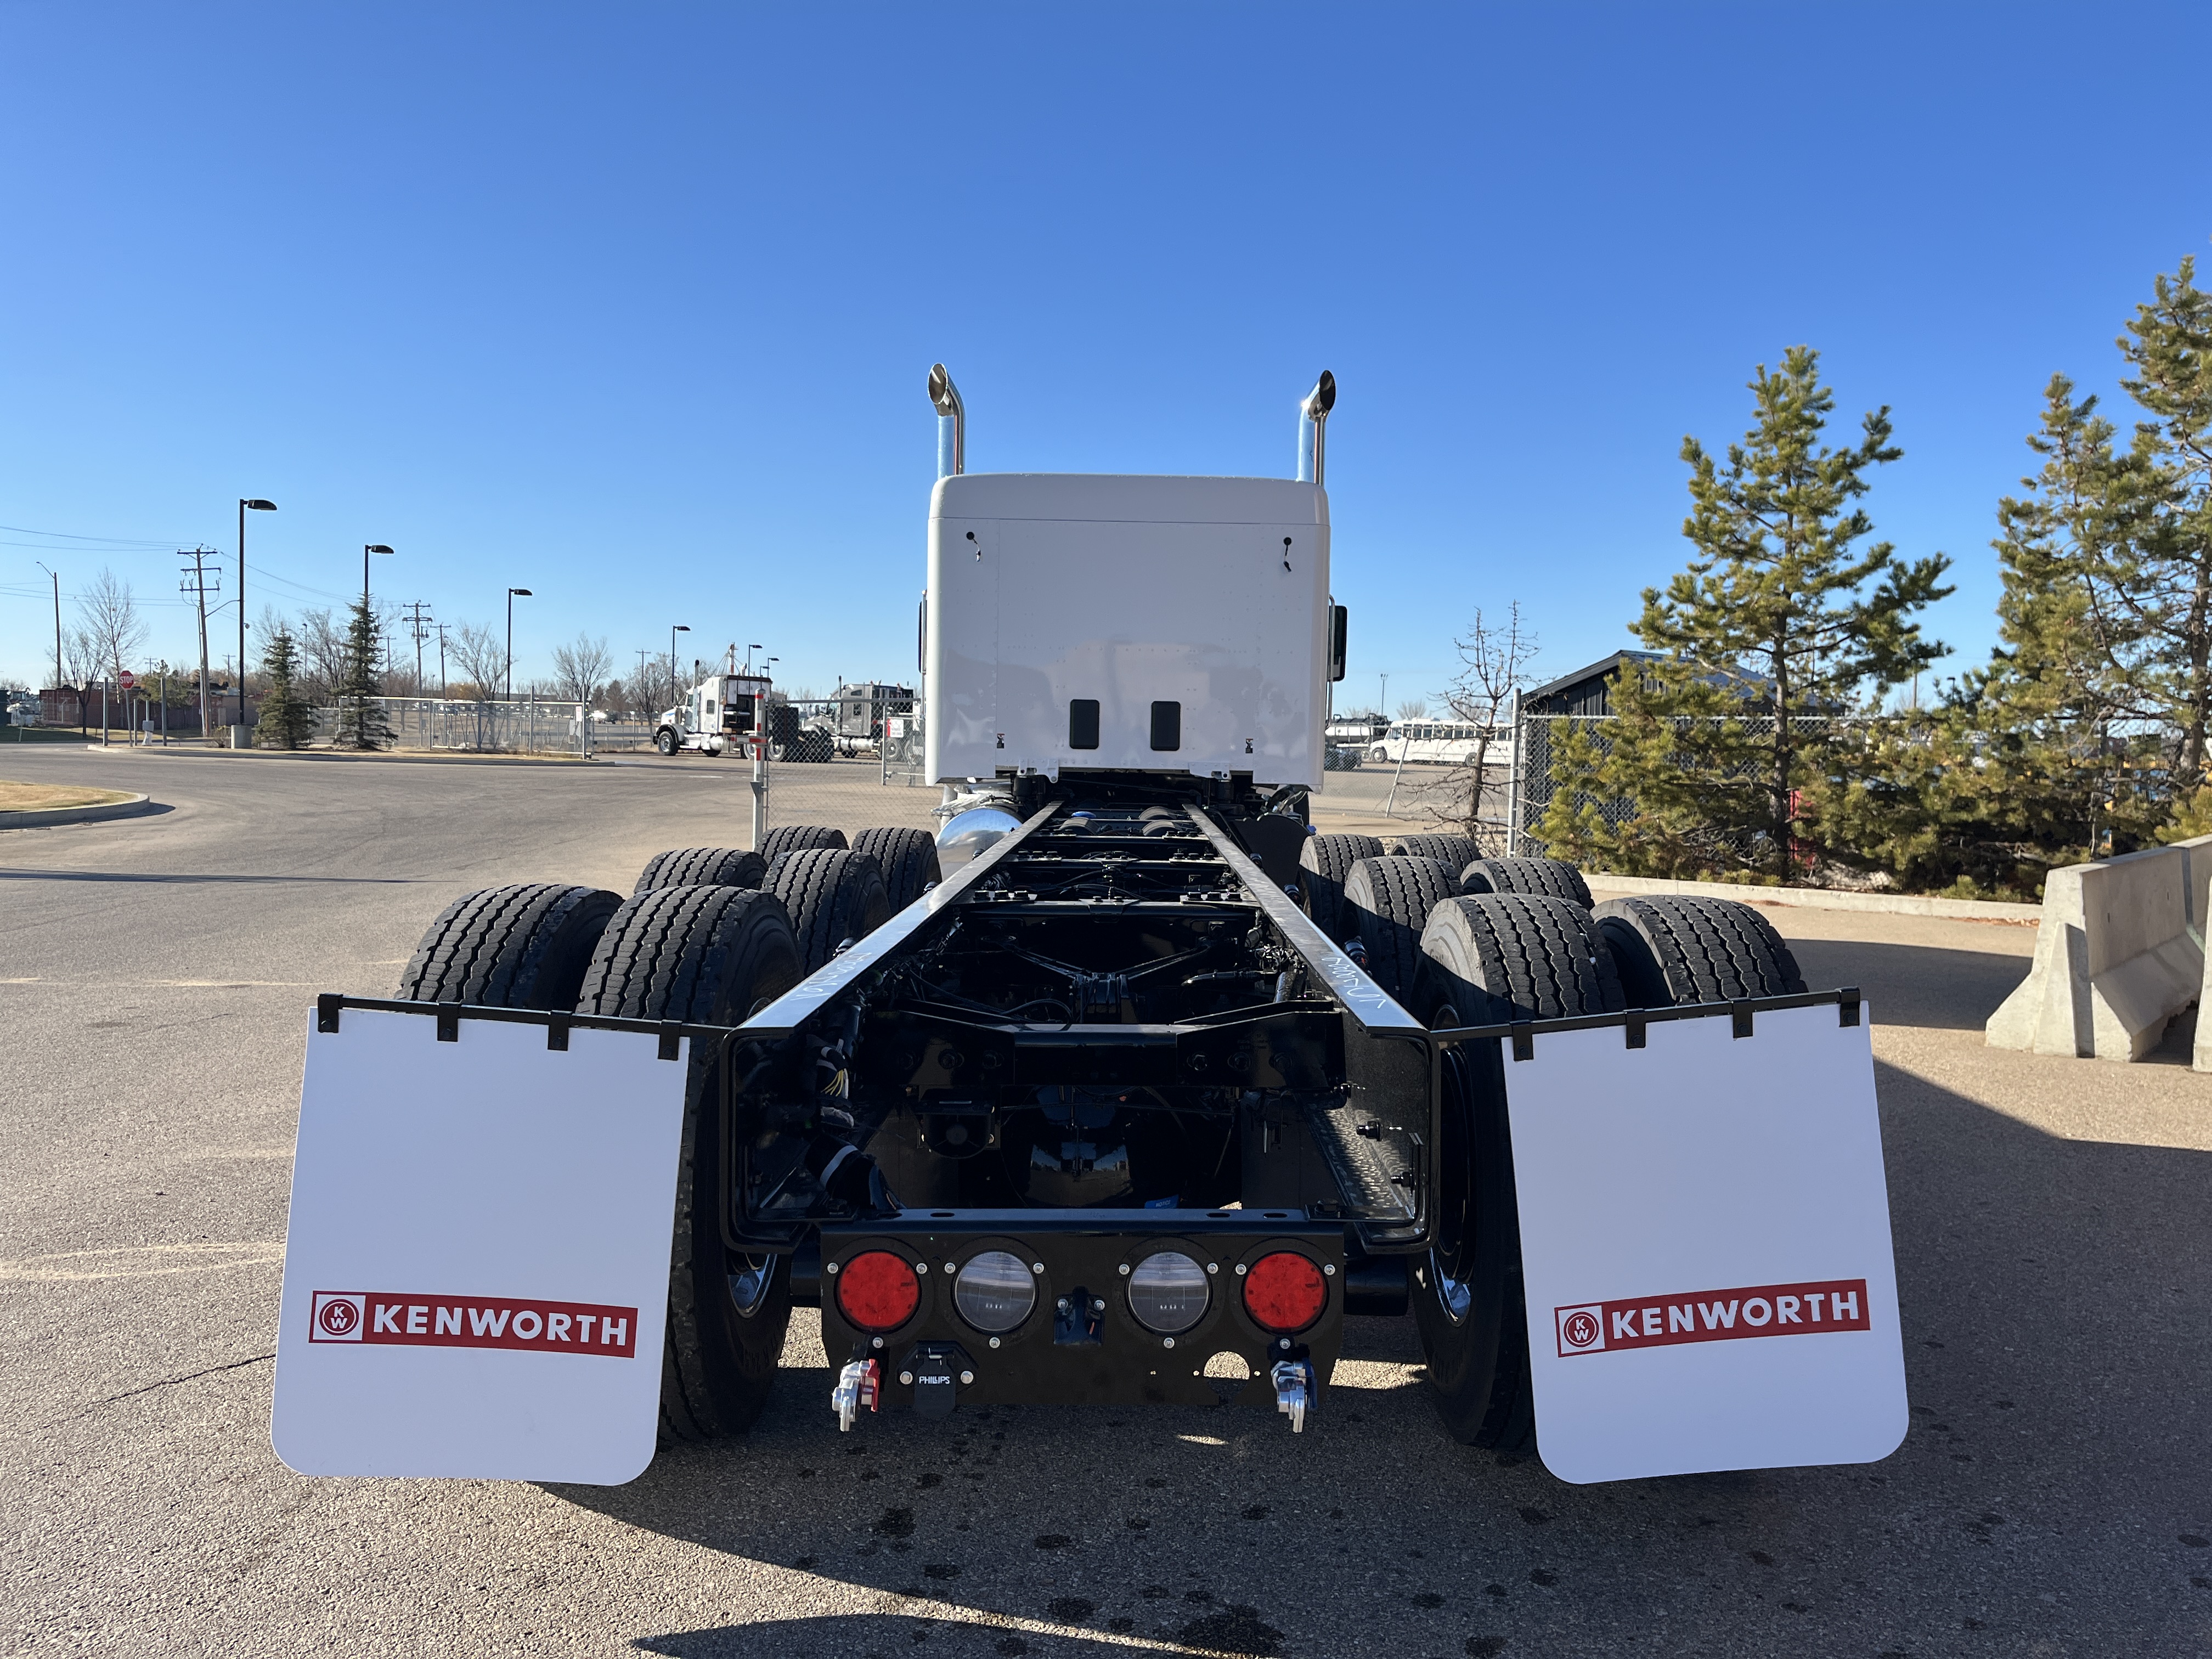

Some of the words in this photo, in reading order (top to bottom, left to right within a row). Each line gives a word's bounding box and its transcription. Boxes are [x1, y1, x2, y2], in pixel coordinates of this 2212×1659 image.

[120, 676, 133, 684] STOP
[373, 1304, 627, 1346] KENWORTH
[1611, 1291, 1859, 1340] KENWORTH
[918, 1376, 950, 1384] PHILLIPS
